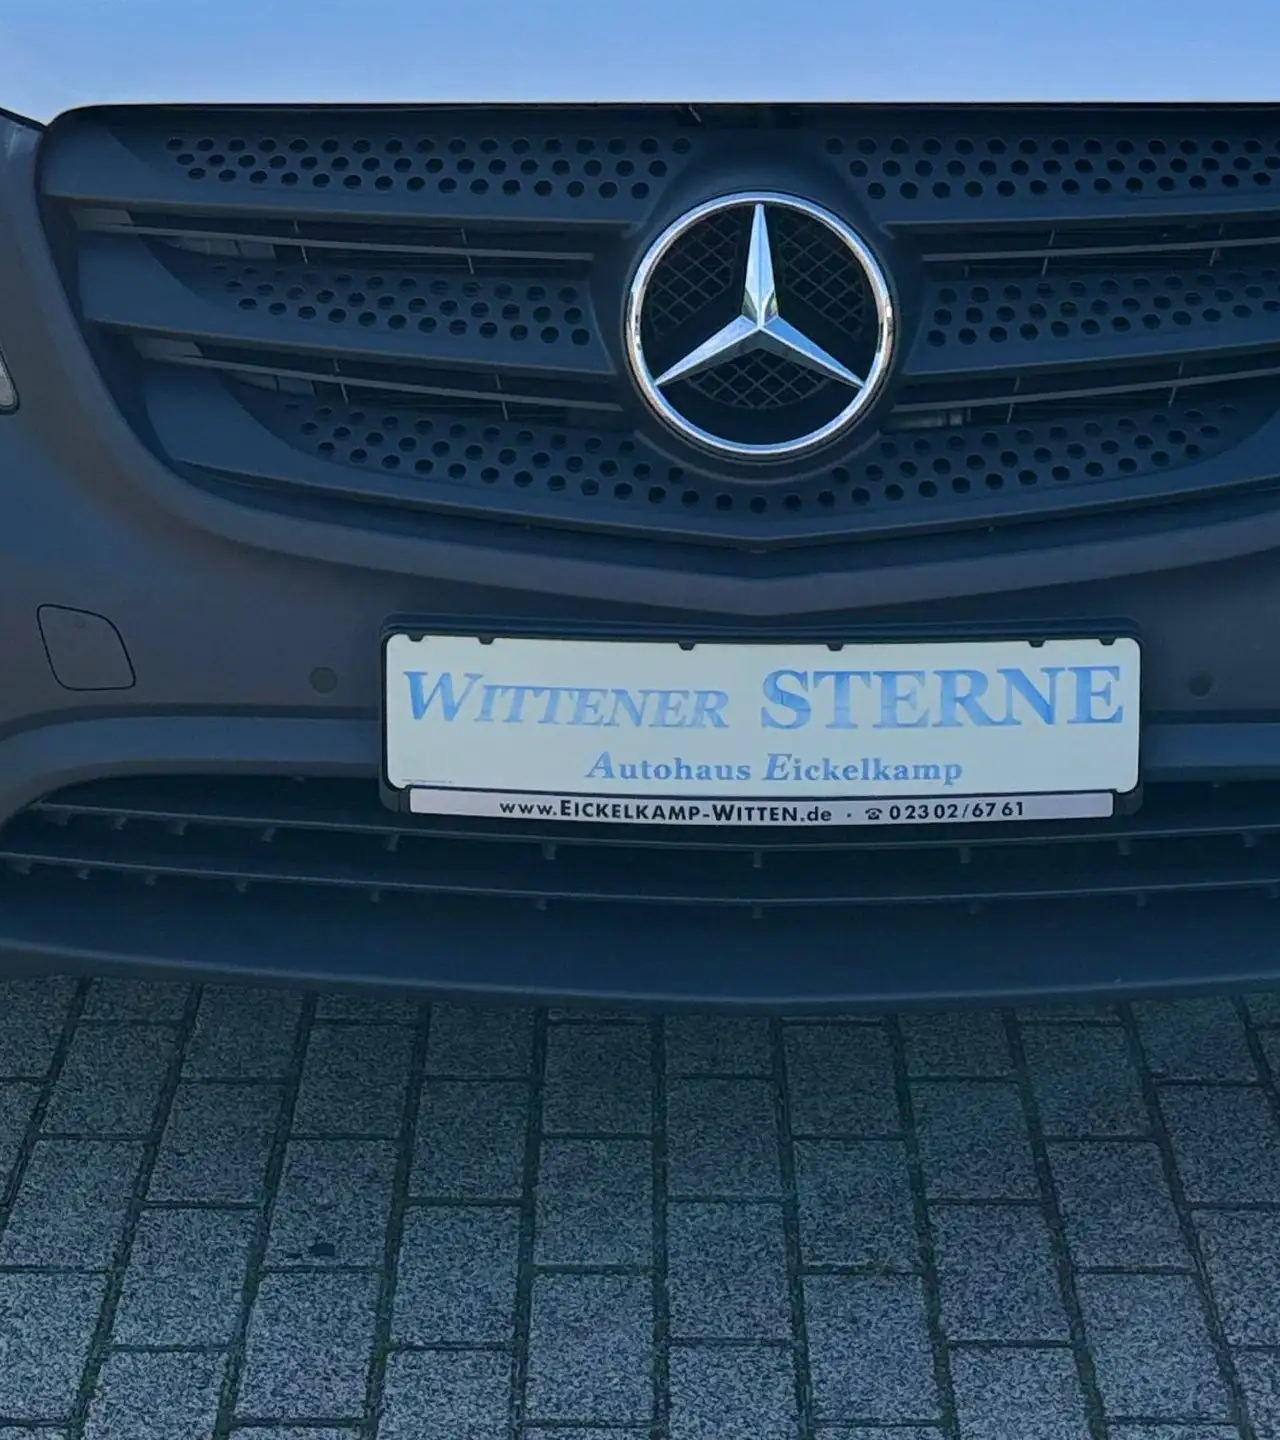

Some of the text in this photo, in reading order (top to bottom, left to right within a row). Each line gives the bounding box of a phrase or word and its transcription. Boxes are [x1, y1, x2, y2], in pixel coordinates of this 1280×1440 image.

[403, 664, 1125, 730] WITTENER STERNE
[586, 751, 963, 786] Autohaus Eickelkamp
